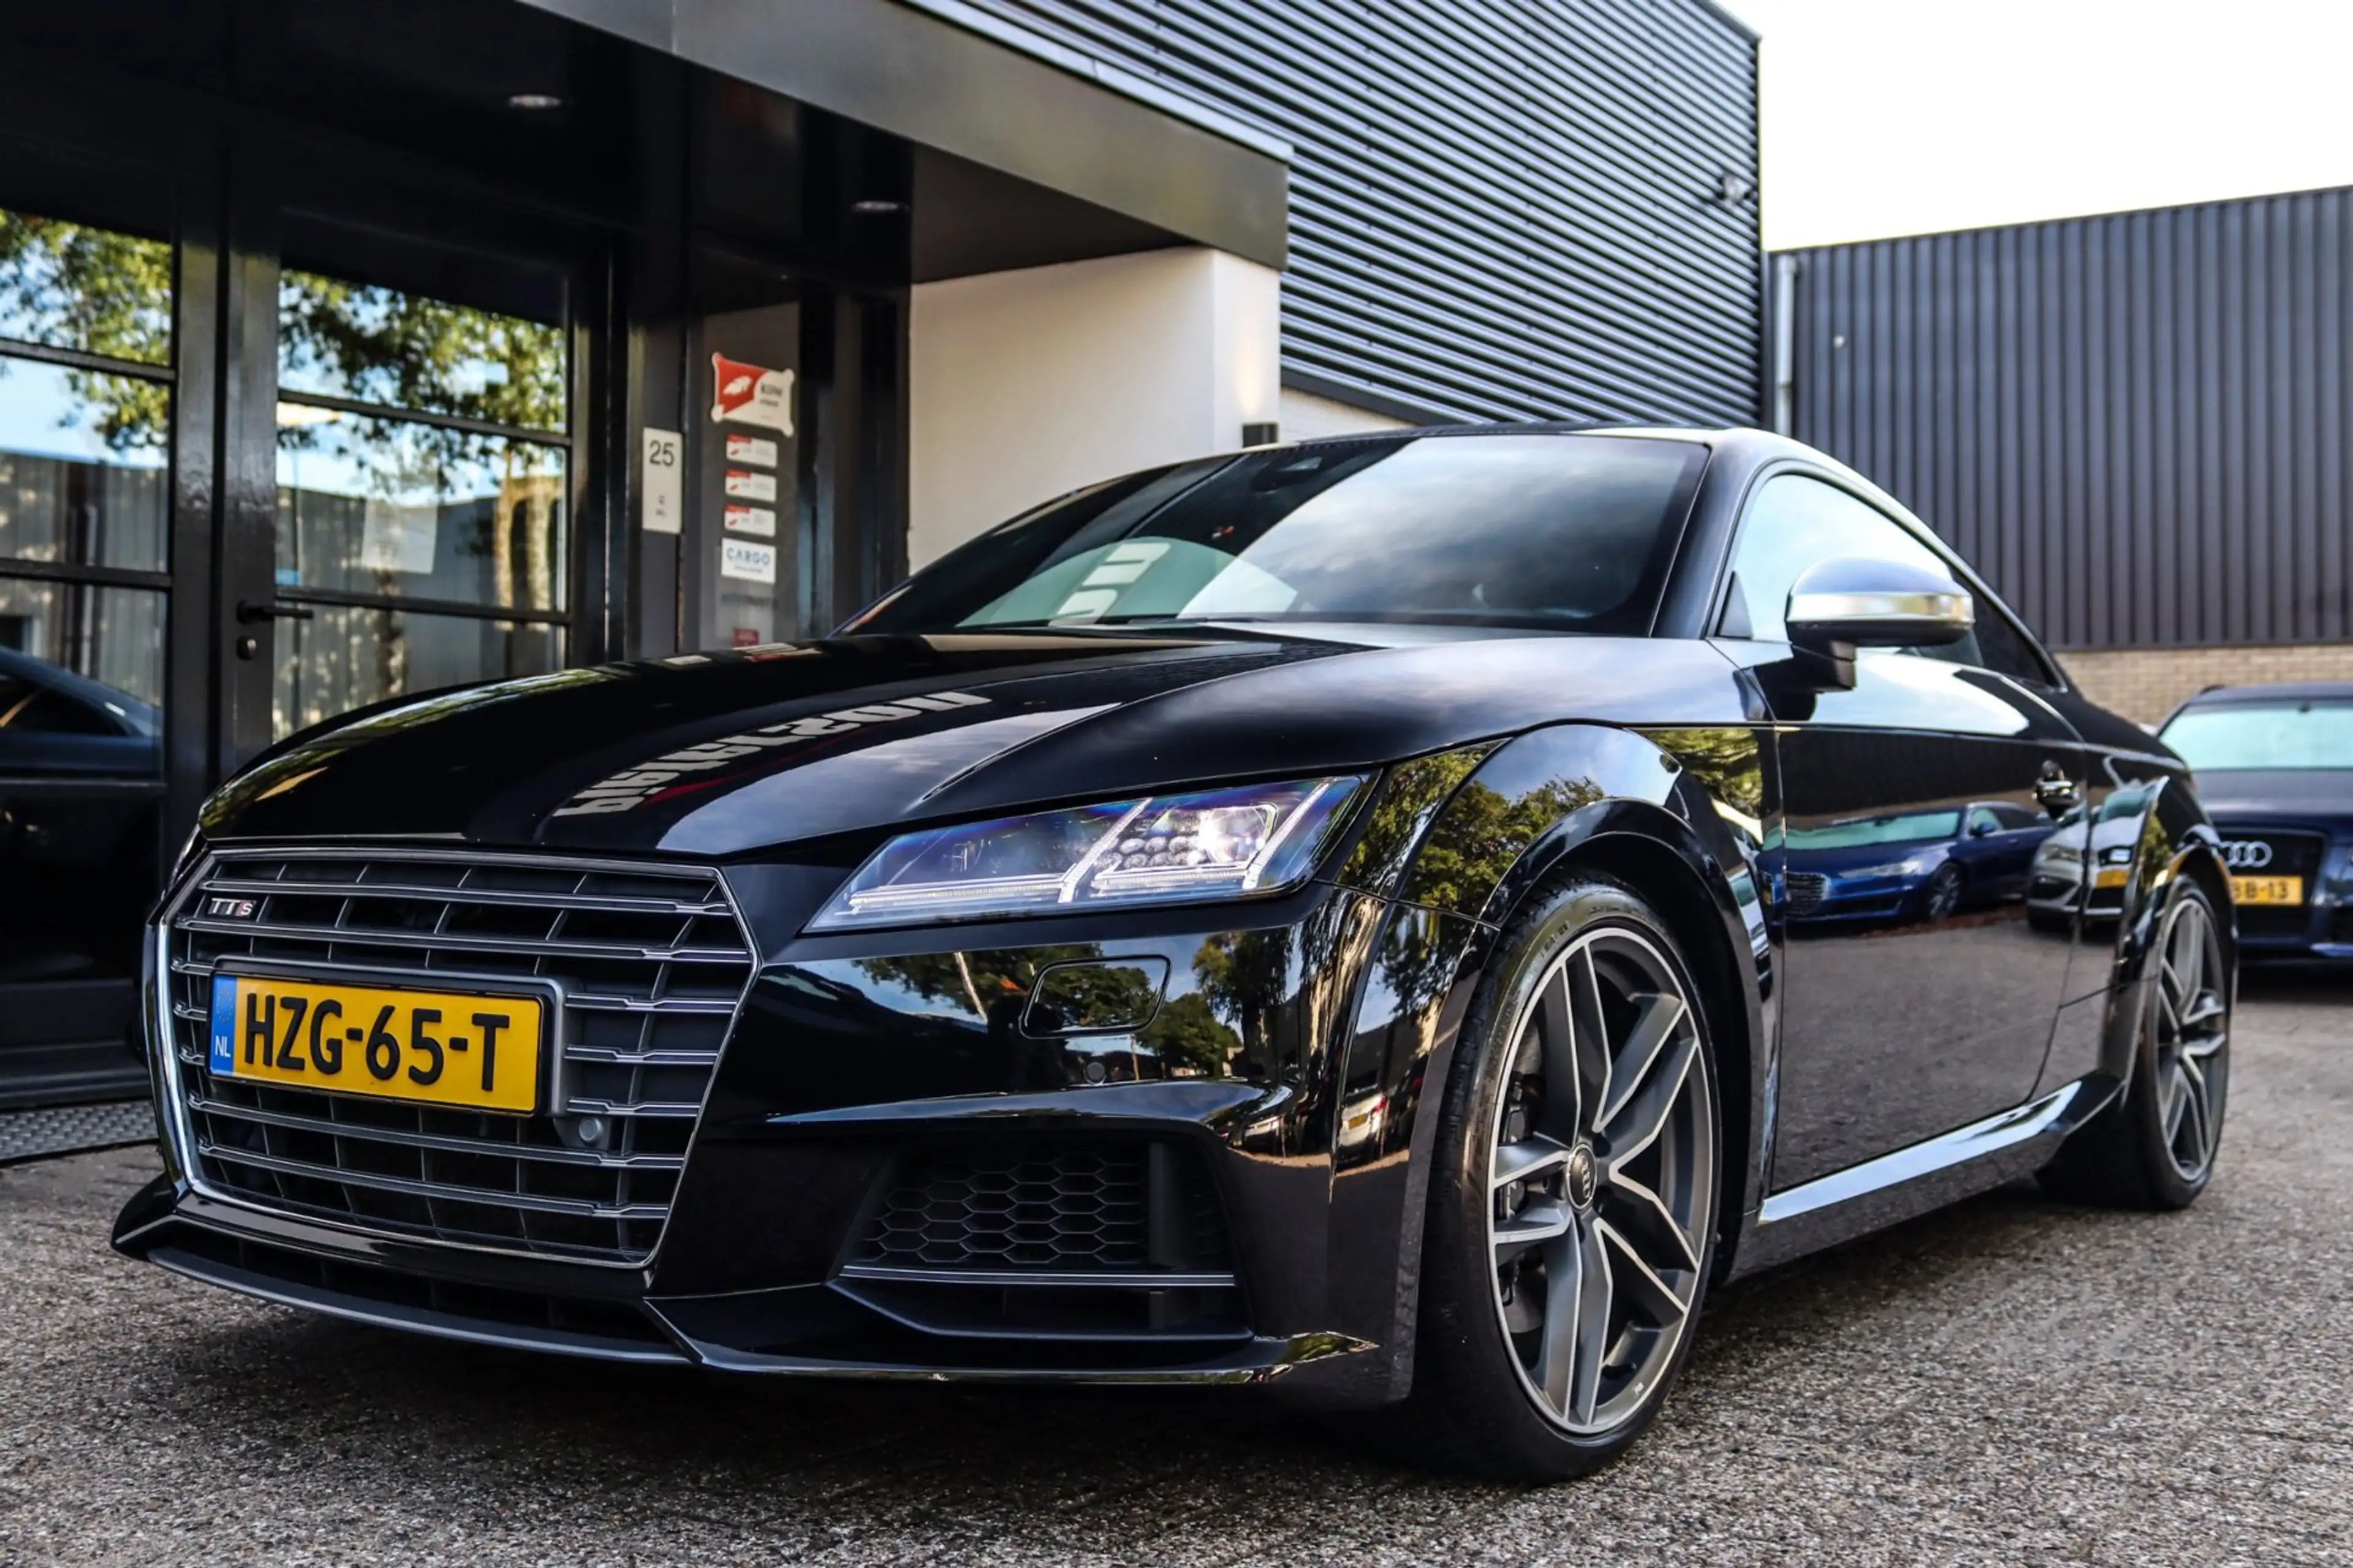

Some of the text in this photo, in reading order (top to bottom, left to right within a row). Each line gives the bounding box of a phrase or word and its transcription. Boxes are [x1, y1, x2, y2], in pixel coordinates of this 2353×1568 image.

[650, 439, 675, 468] 25
[726, 547, 770, 566] CARGO
[211, 898, 254, 915] TTS
[214, 1035, 231, 1058] NL
[244, 993, 510, 1092] HZG-65-T
